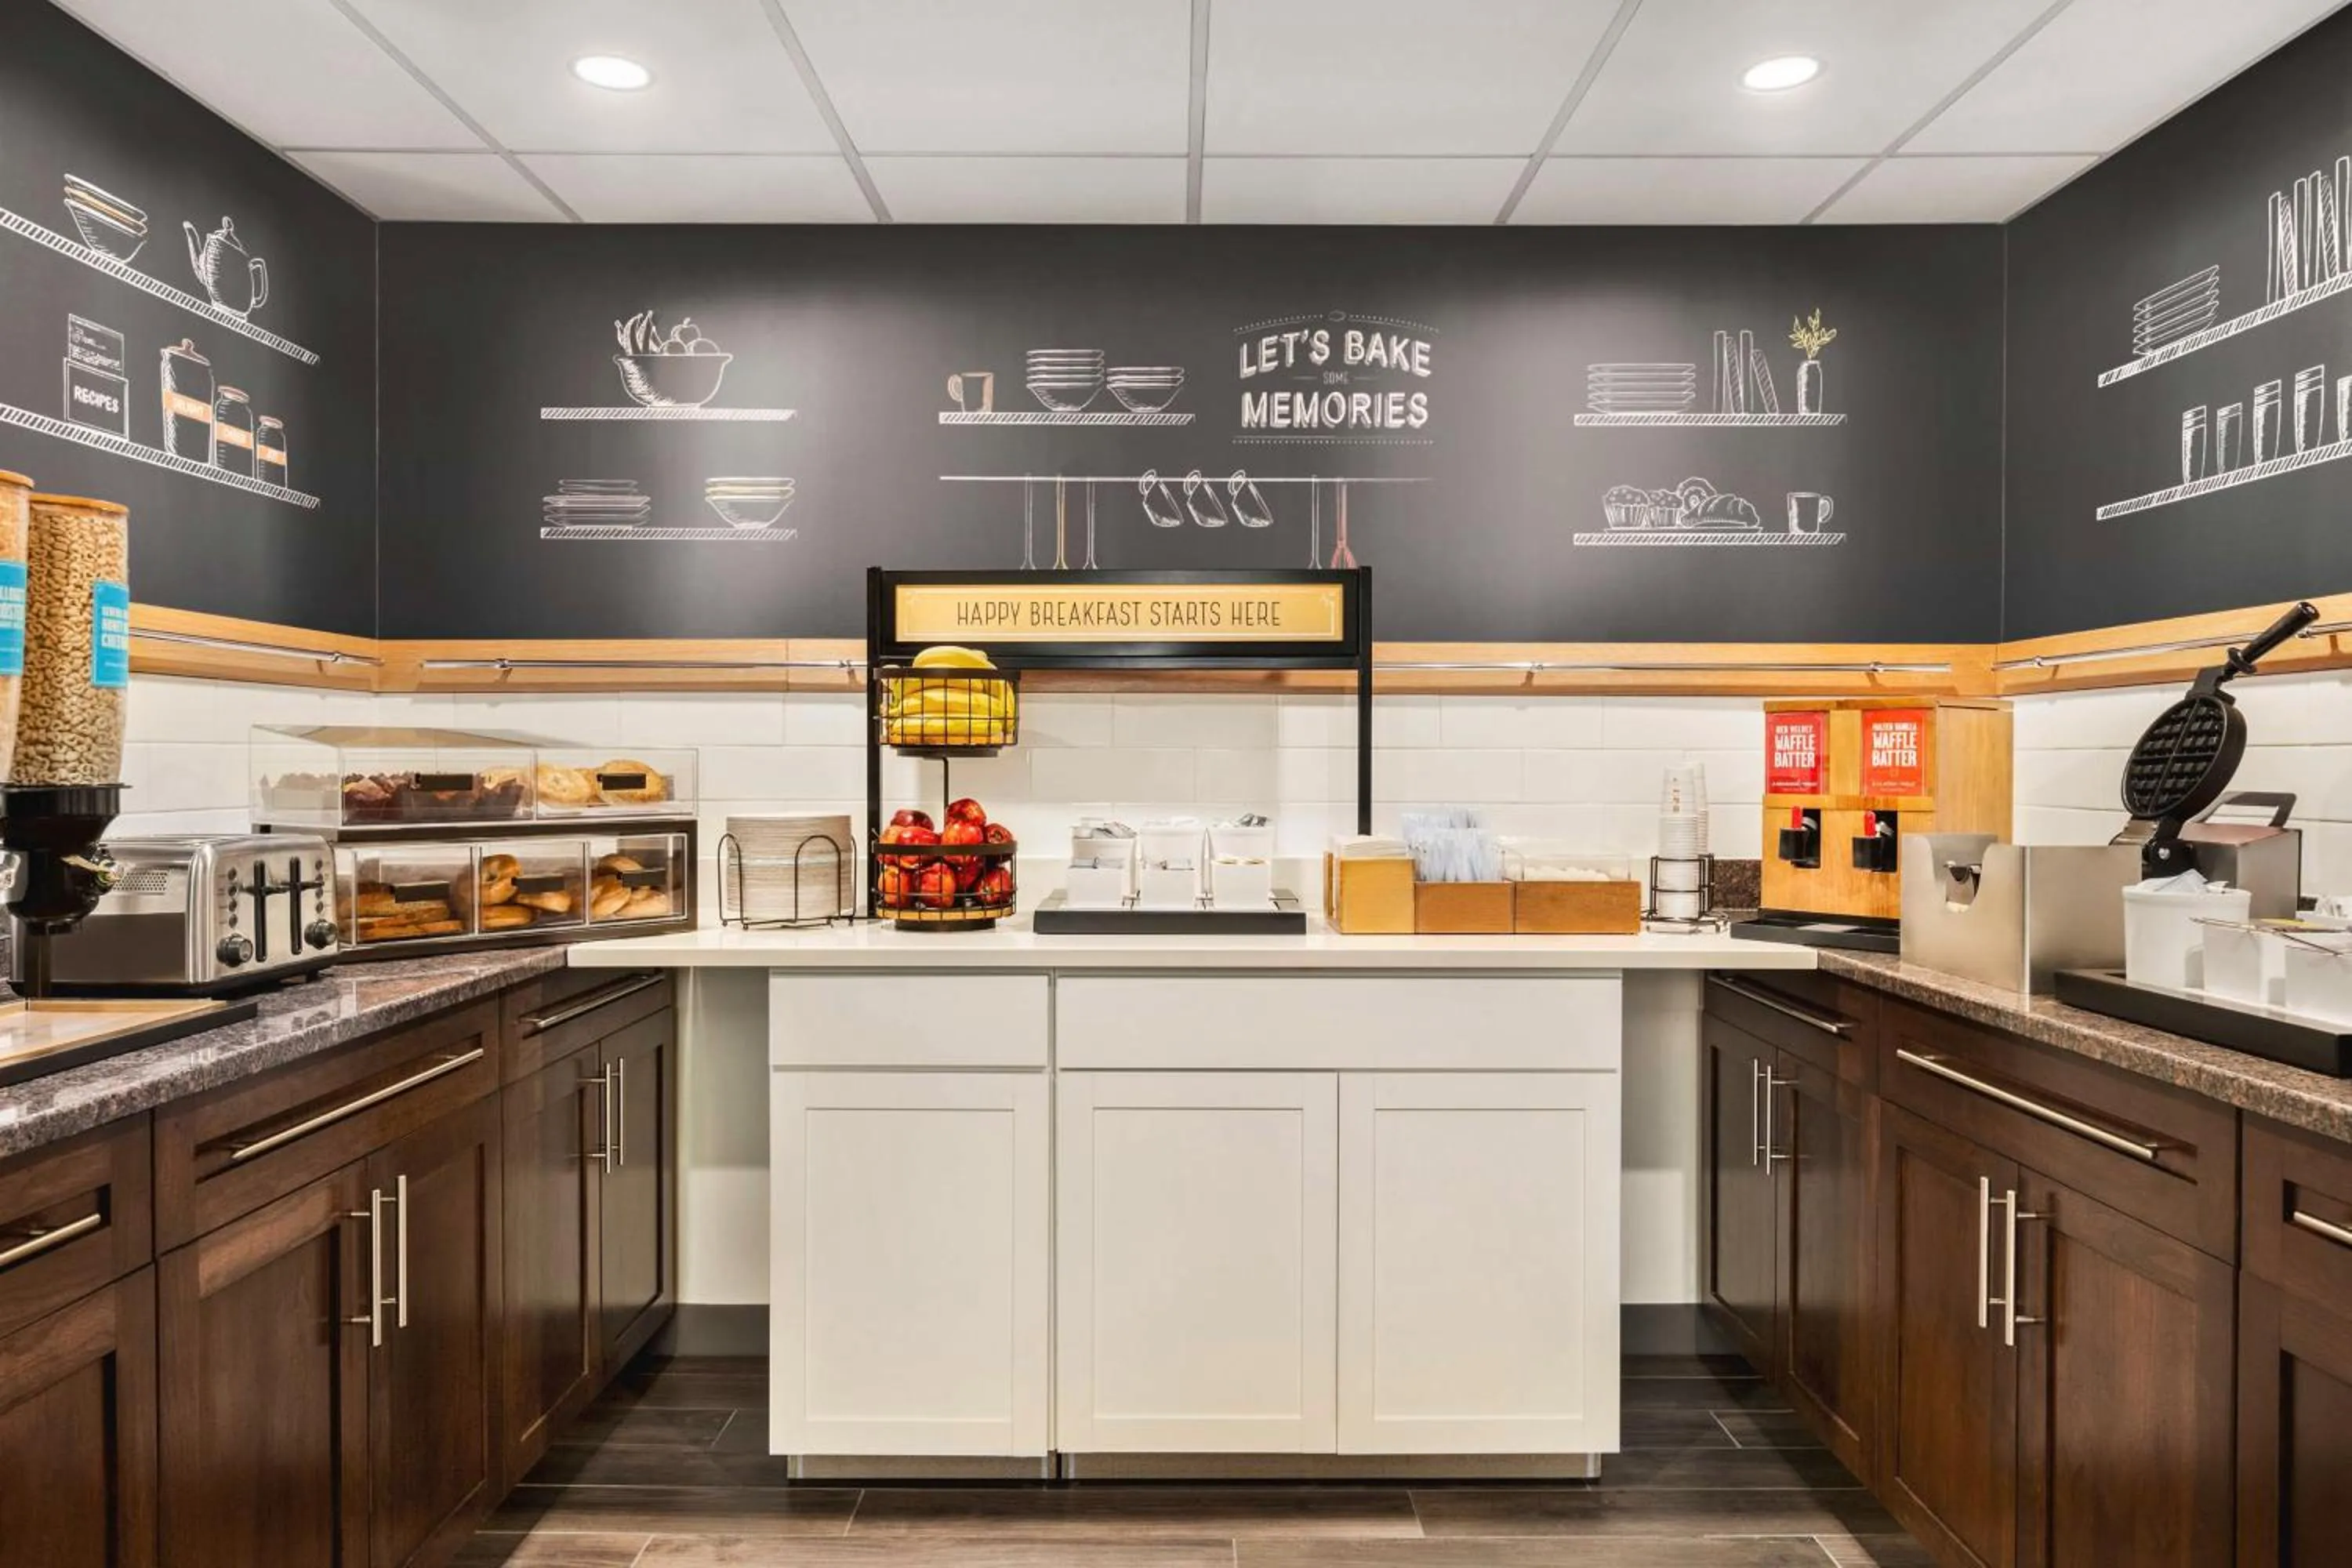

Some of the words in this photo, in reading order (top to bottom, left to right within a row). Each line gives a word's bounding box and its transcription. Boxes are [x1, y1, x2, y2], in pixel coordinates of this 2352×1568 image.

[1240, 328, 1330, 379] LET'S
[1344, 329, 1432, 377] BAKE
[1322, 371, 1349, 384] SOME
[74, 385, 119, 413] RECIPES
[1241, 391, 1428, 428] MEMORIES
[956, 601, 1021, 626] HAPPY
[1030, 601, 1142, 626] BREAKFAST
[1150, 601, 1221, 626] STARTS
[1232, 601, 1281, 626] HERE
[1775, 734, 1815, 750] WAFFLE
[1872, 731, 1917, 749] WAFFLE
[1774, 751, 1815, 768] BATTER
[1871, 750, 1917, 767] BATTER
